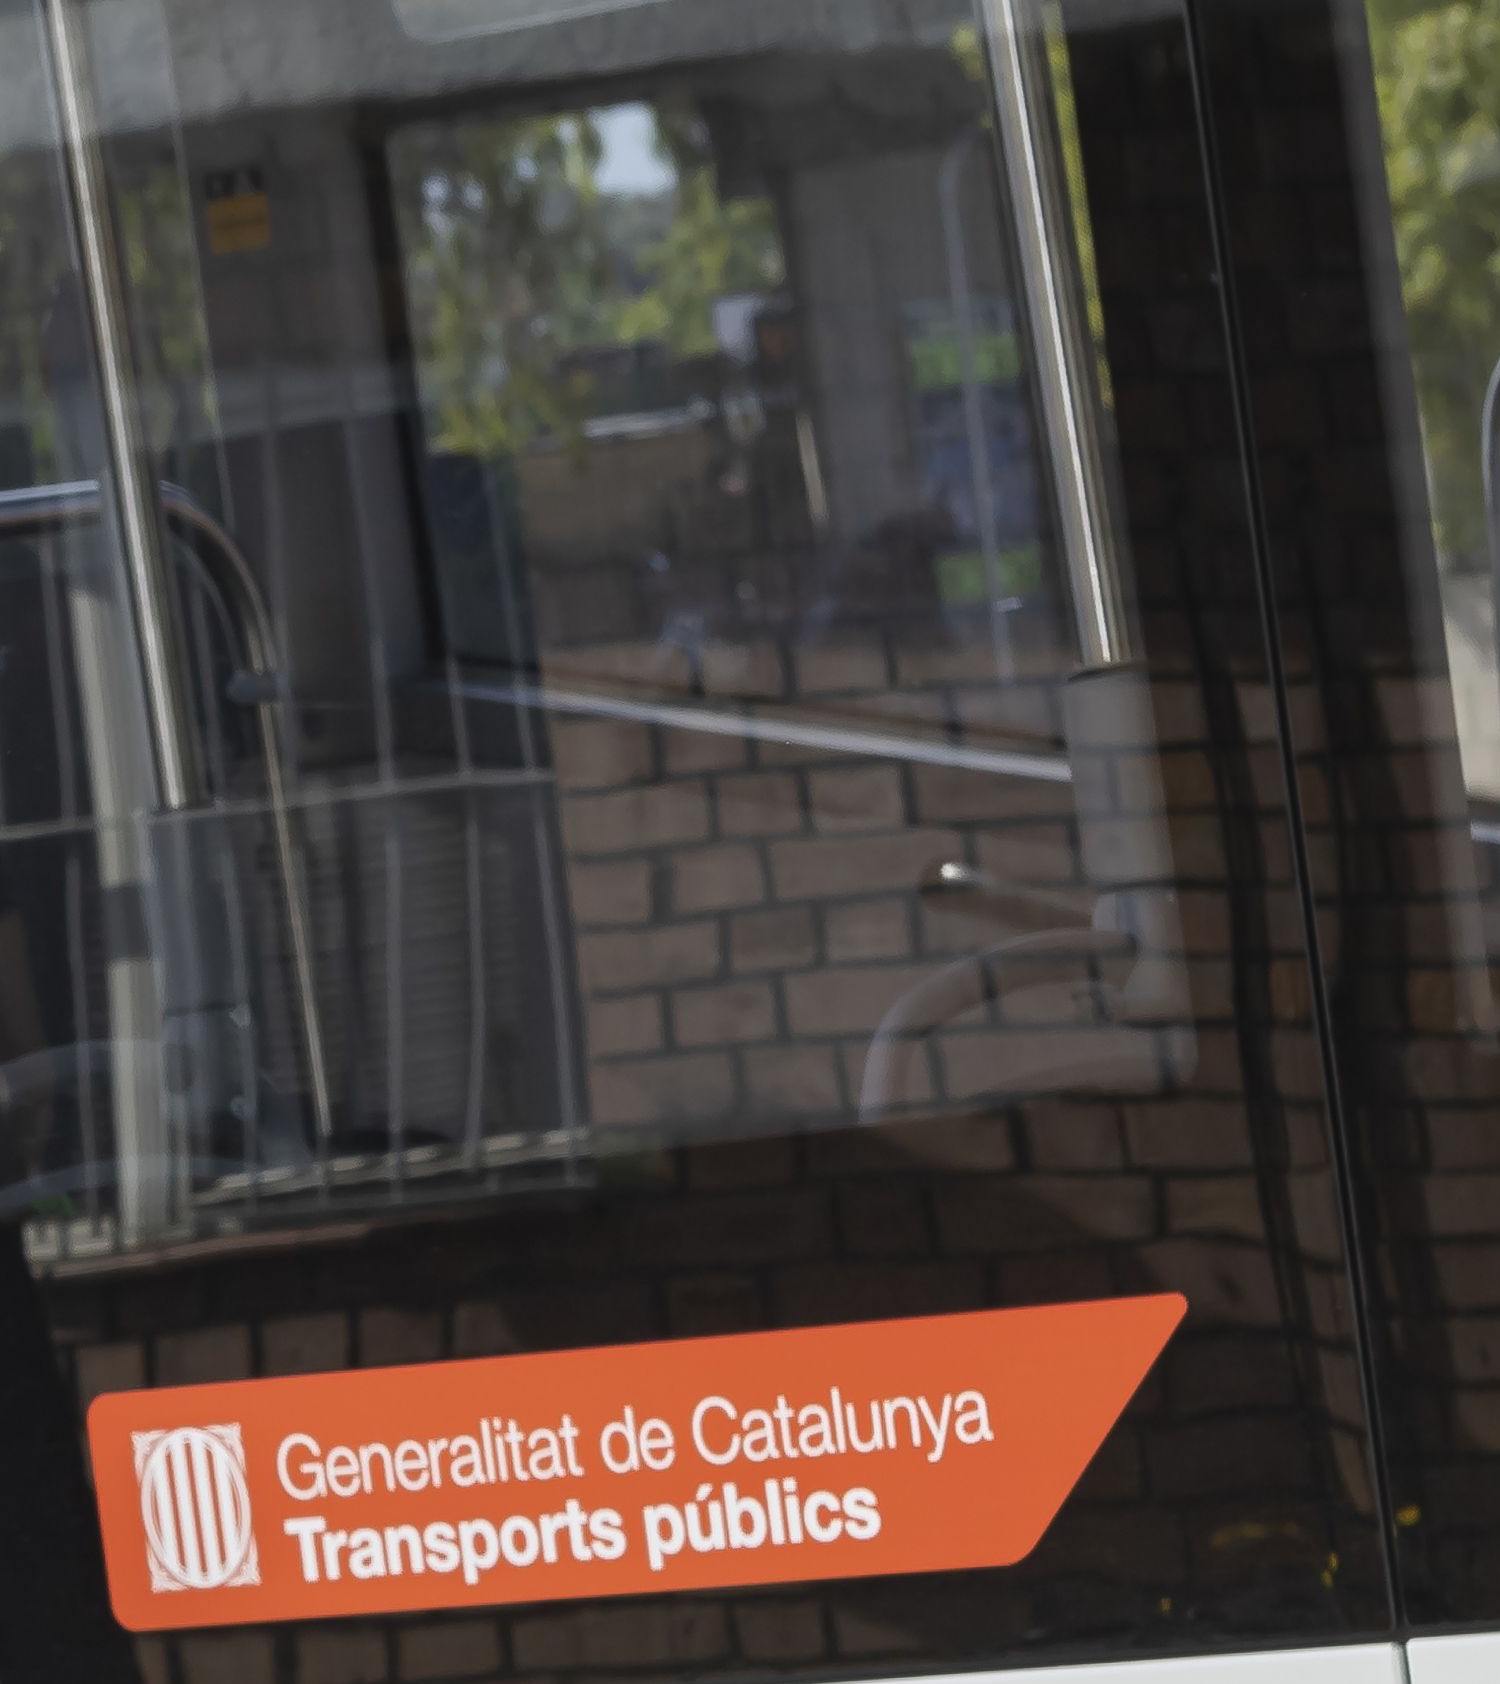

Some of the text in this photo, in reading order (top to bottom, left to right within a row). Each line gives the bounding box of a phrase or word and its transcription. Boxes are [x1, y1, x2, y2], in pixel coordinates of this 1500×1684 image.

[276, 1386, 996, 1502] Generalitat de Catalunya
[283, 1476, 883, 1586] Transports públics
